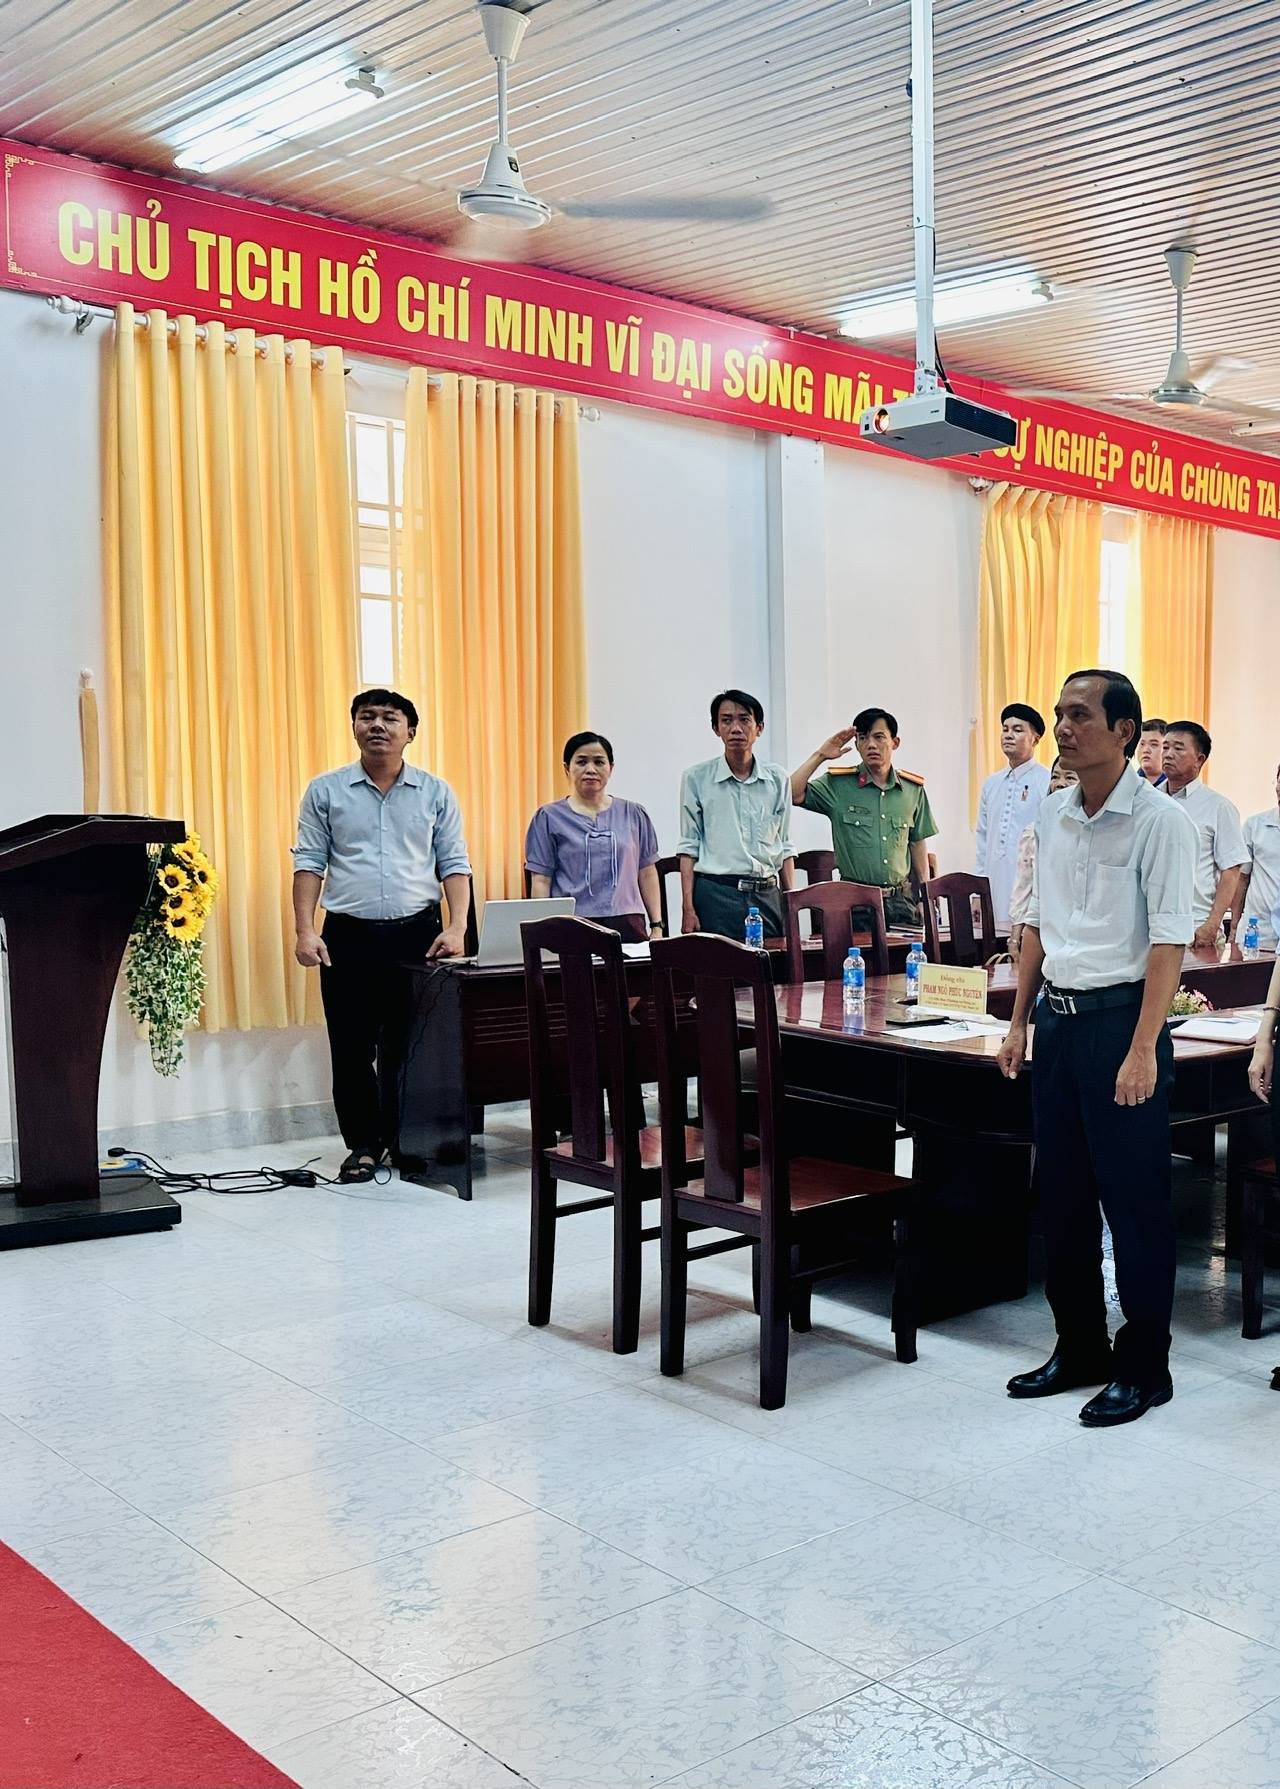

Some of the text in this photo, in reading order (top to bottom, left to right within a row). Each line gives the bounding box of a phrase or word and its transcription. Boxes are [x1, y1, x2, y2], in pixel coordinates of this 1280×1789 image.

[58, 199, 170, 281] CHỦ
[187, 228, 302, 309] TỊCH
[319, 248, 381, 324] HỒ
[397, 276, 471, 342] CHÍ
[485, 294, 593, 367] MINH
[605, 314, 643, 377] VĨ
[651, 331, 711, 399] ĐẠI
[722, 340, 814, 415] SỐNG
[1034, 424, 1124, 489] NGHIỆP
[1130, 441, 1174, 497] CỦA
[1180, 462, 1251, 513] CHÚNG
